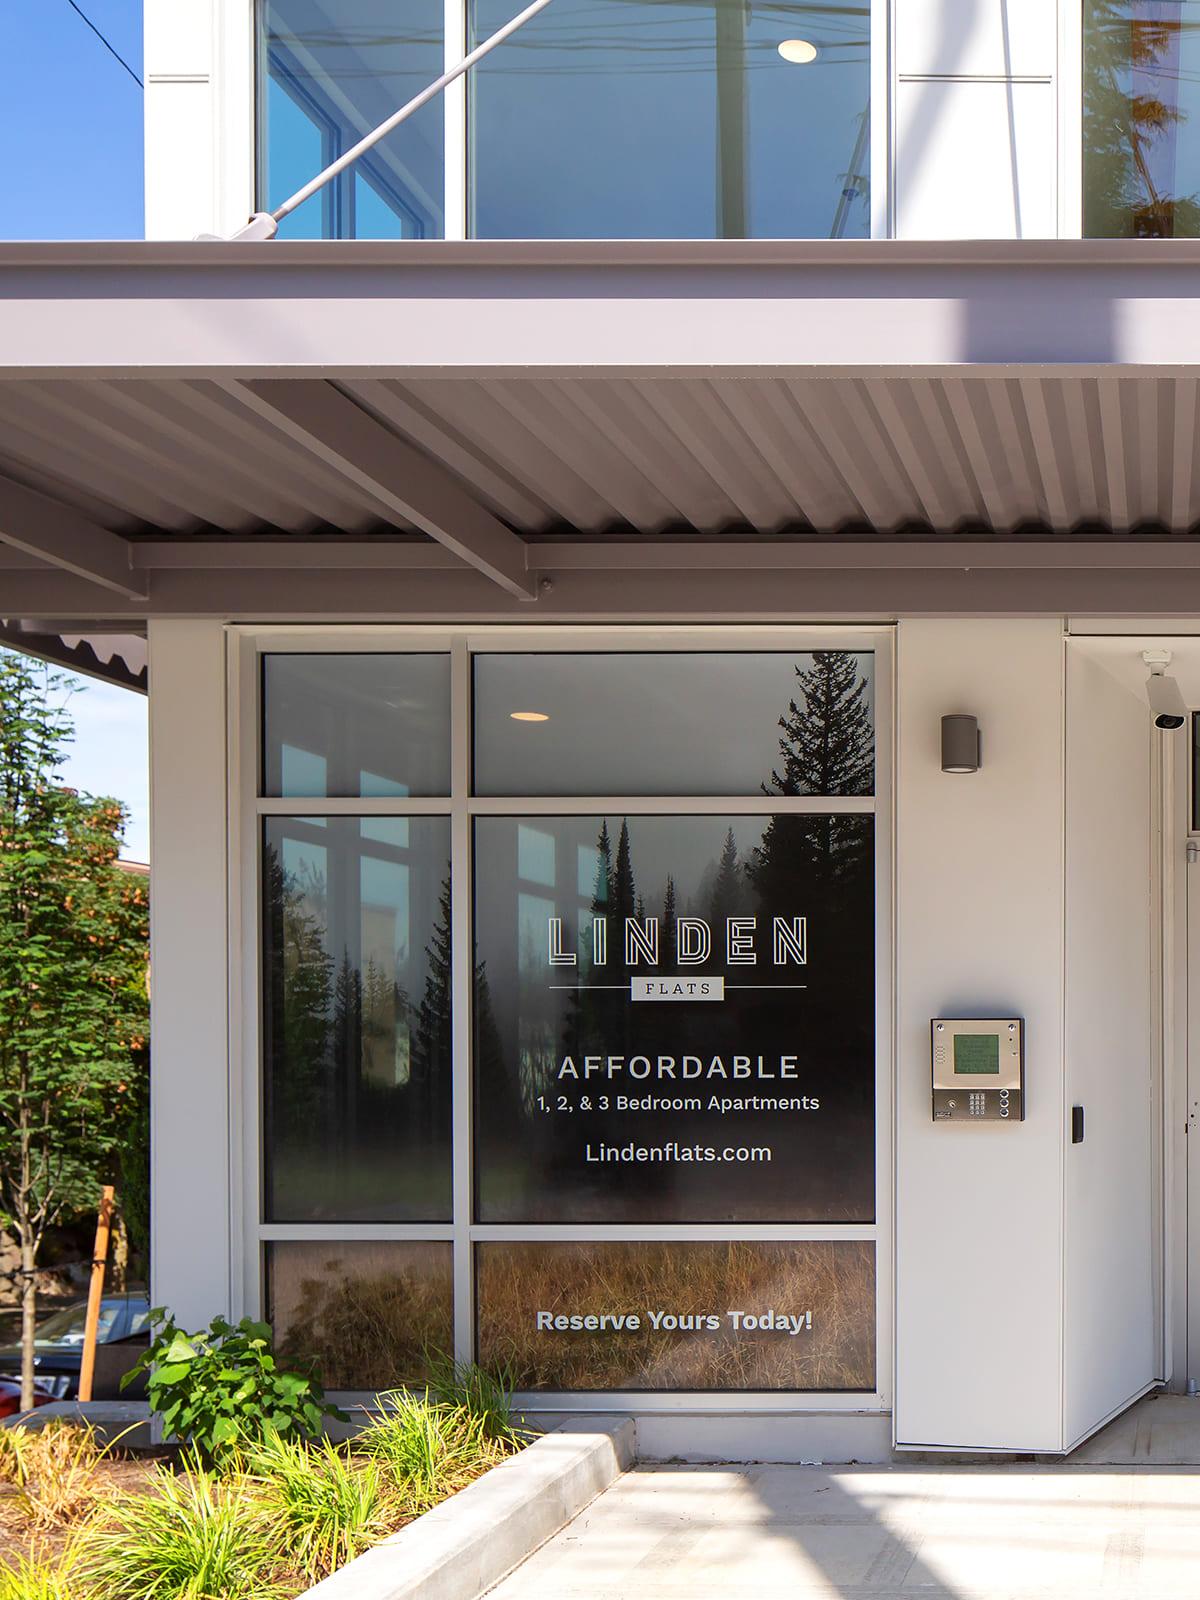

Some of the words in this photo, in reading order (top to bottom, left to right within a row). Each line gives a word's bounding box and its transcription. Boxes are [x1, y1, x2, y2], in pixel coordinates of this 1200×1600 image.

[548, 917, 807, 965] LINDEN
[645, 982, 712, 996] FLATS
[557, 1055, 800, 1080] AFFORDABLE
[536, 1096, 551, 1113] 1,
[557, 1096, 574, 1113] 2,
[579, 1096, 593, 1111] &
[598, 1096, 610, 1111] 3
[616, 1095, 702, 1111] Bedroom
[707, 1096, 821, 1114] Apartments
[585, 1142, 772, 1163] Lindenflats.com
[536, 1310, 641, 1331] Reserve
[648, 1310, 721, 1331] Yours
[727, 1310, 813, 1336] Today!
